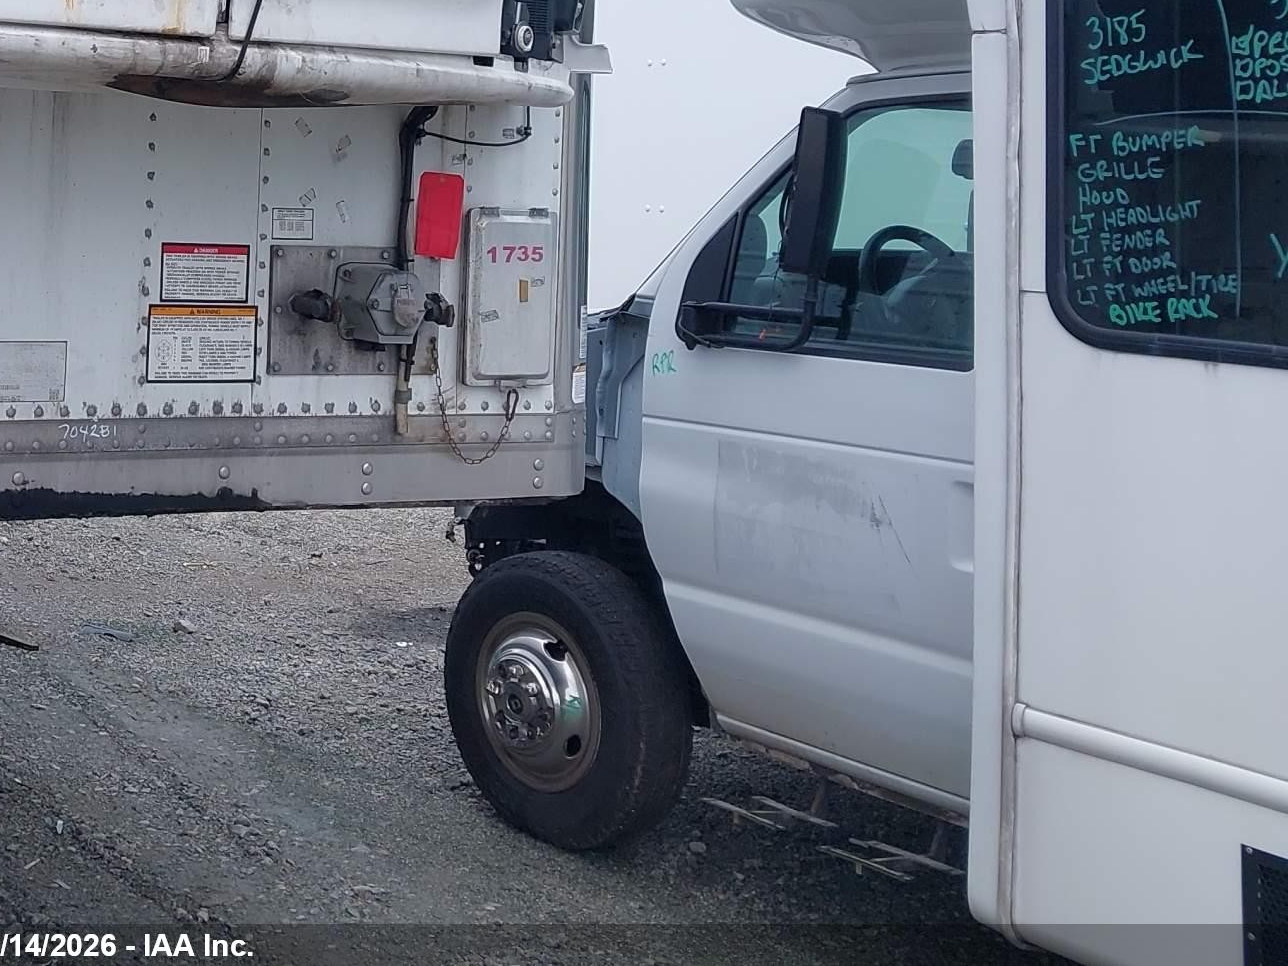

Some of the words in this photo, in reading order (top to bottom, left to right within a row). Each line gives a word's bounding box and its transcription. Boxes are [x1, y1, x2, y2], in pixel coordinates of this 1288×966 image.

[1085, 8, 1146, 50] 3185
[1080, 39, 1205, 85] SEDGWICK
[1069, 134, 1102, 157] FT
[1112, 125, 1205, 157] BUMPER
[1077, 156, 1165, 183] GRILLE
[1072, 212, 1095, 235] LT
[1102, 199, 1202, 232] HEADLIGHT
[487, 245, 544, 264] 1735
[1071, 234, 1091, 256] LT
[1100, 228, 1170, 252] FENDER
[1072, 258, 1095, 280] LT
[1103, 255, 1124, 276] FT
[1128, 251, 1177, 274] DOOR
[1109, 301, 1162, 326] BIKE
[1168, 294, 1219, 323] RACK
